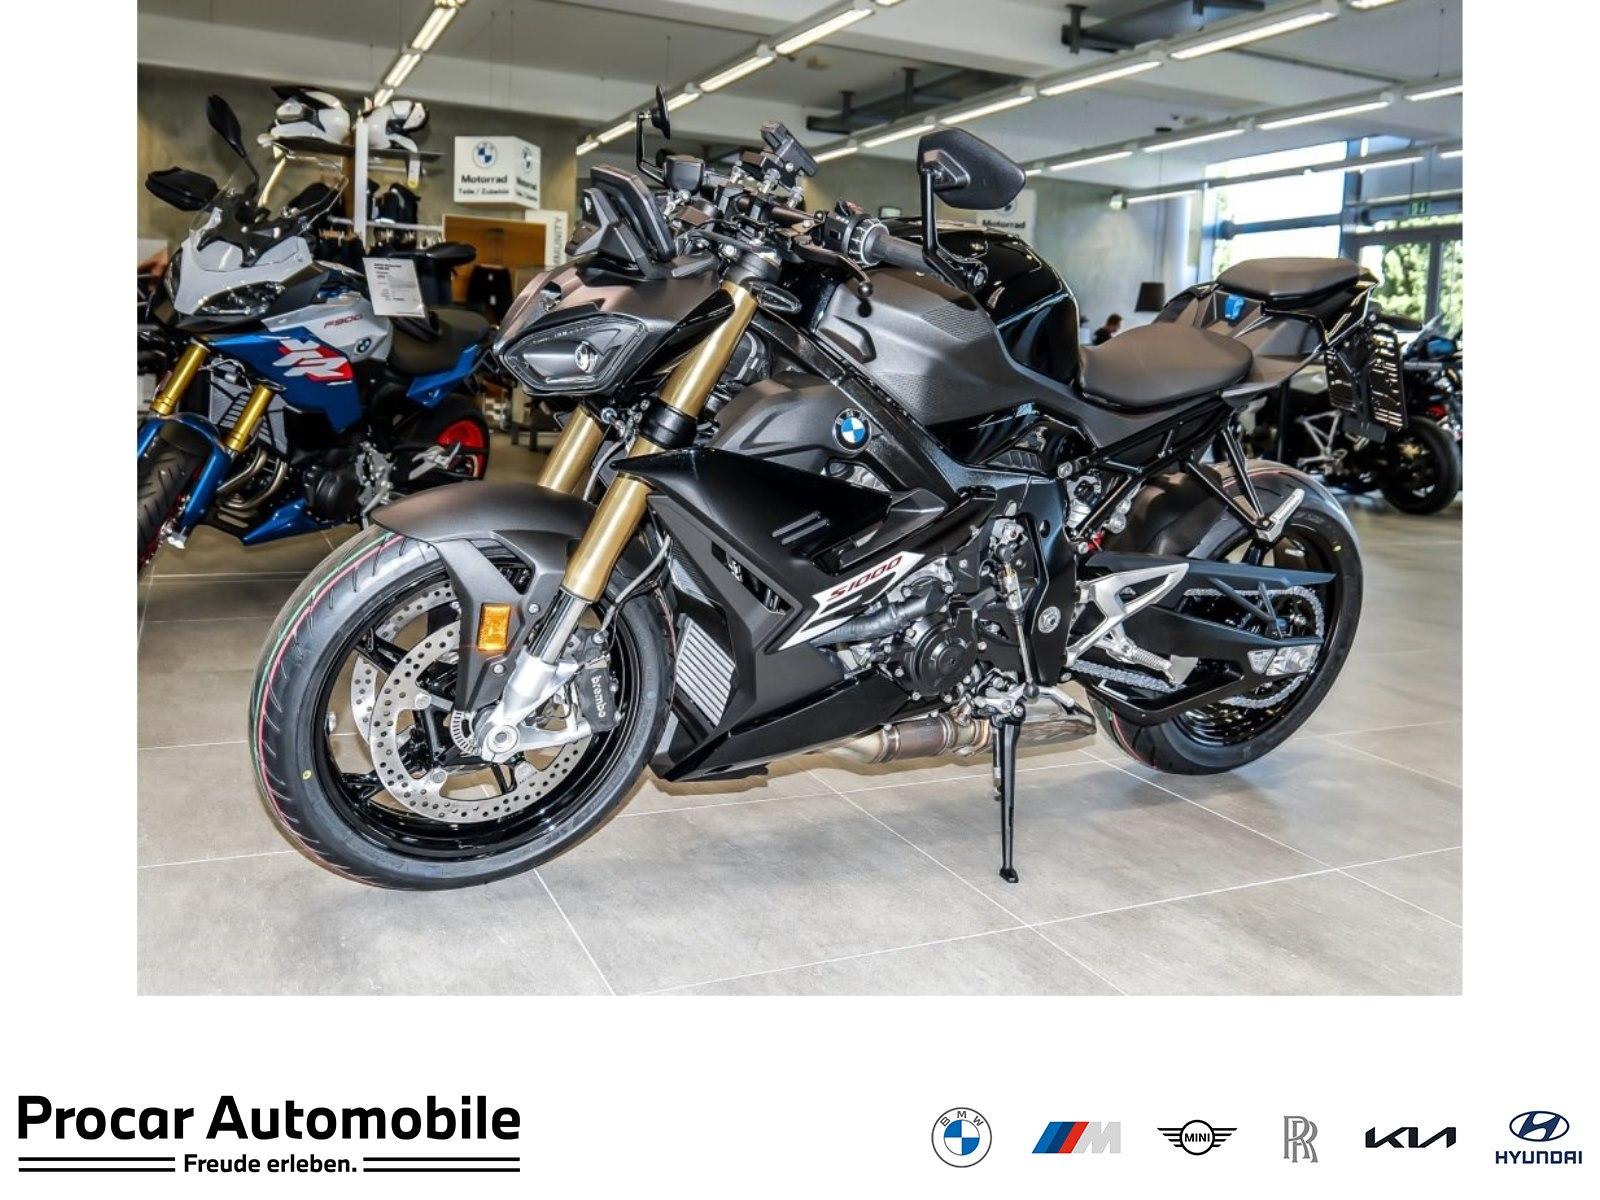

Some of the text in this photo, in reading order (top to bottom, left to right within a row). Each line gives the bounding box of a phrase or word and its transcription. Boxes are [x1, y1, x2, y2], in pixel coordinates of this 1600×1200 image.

[461, 174, 508, 183] Motorrad
[982, 220, 1025, 229] Motorrad
[323, 314, 363, 329] F900
[828, 555, 903, 602] S1000
[591, 675, 607, 718] brembo
